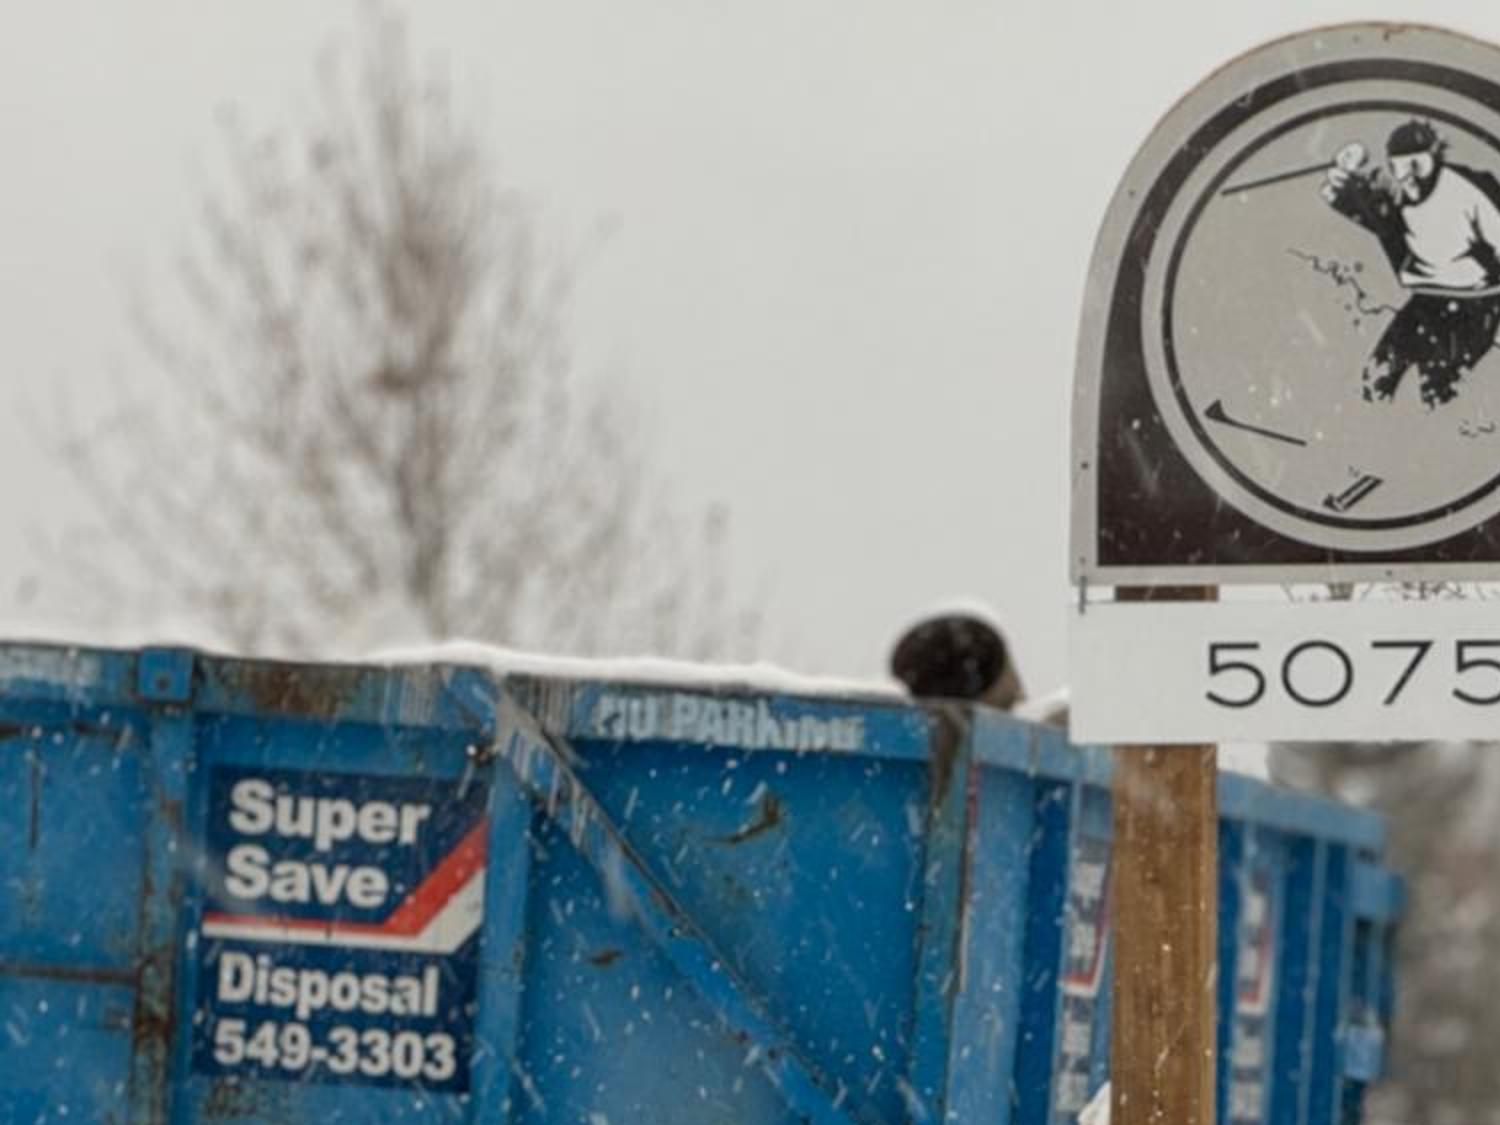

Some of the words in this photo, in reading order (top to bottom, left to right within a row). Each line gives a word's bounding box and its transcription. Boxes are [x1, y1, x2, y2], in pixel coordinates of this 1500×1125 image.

[228, 780, 431, 848] Super
[224, 844, 389, 907] Save
[217, 951, 440, 1018] Disposal
[213, 1019, 458, 1083] 549-3303
